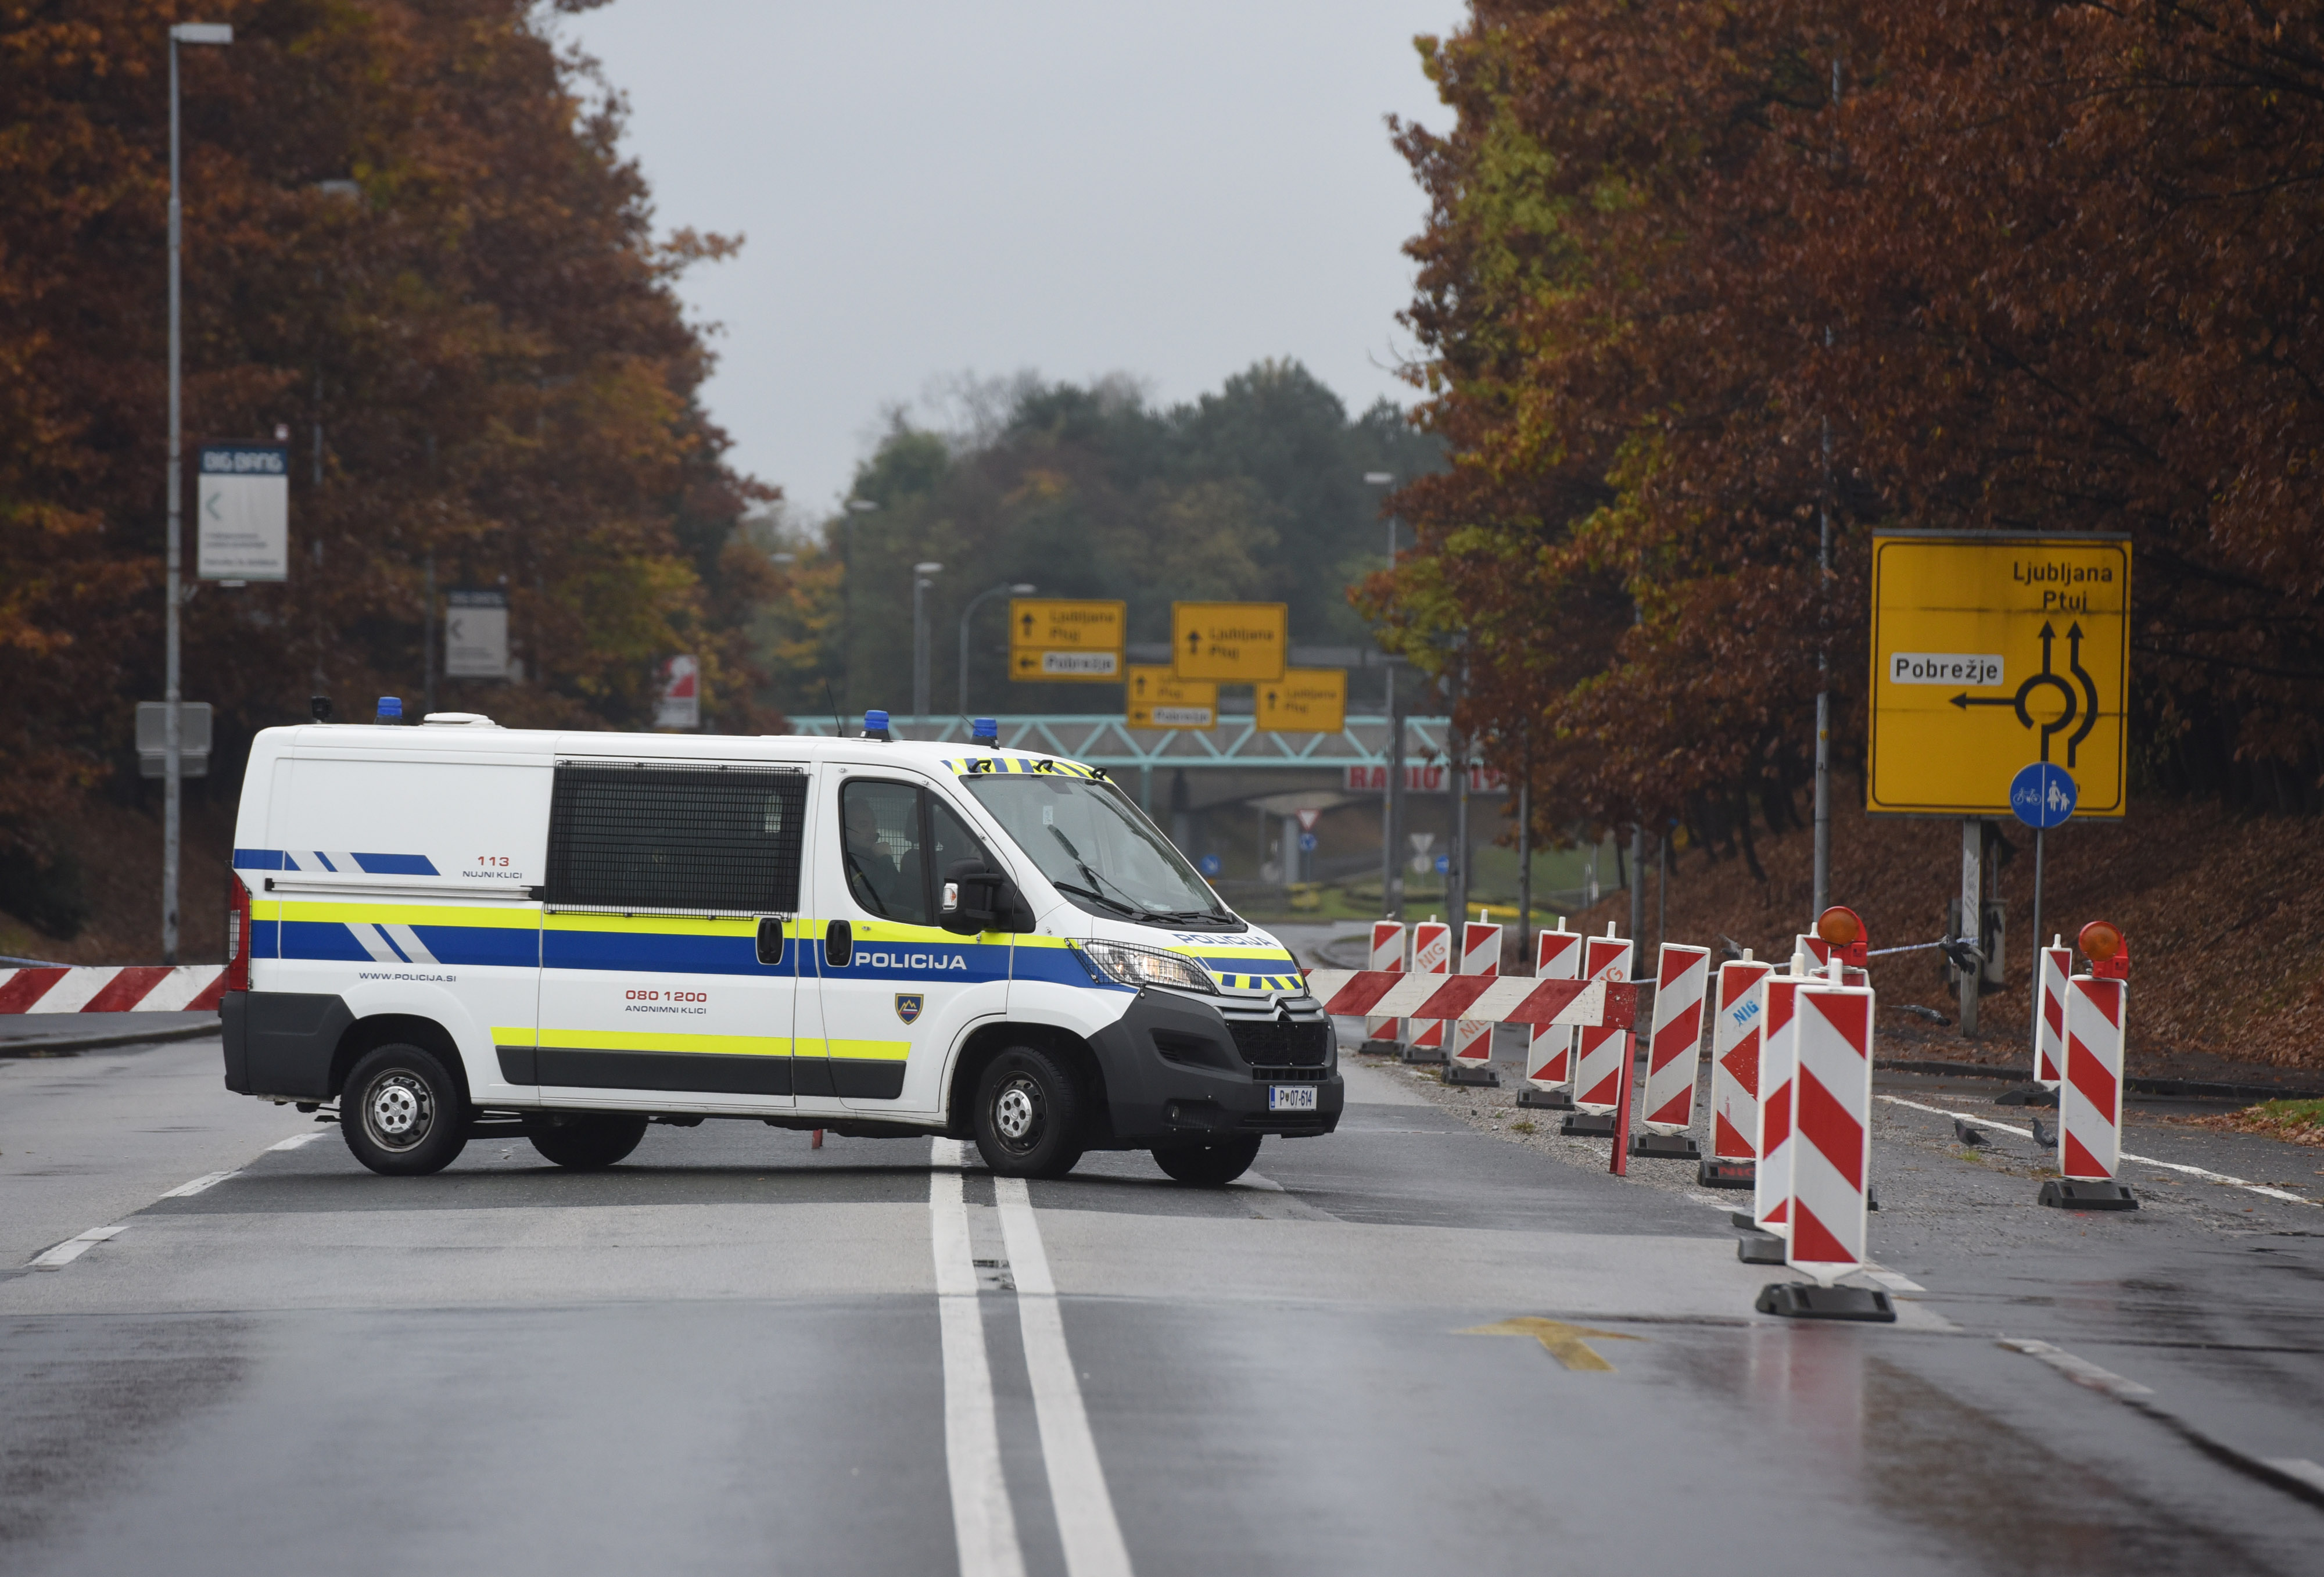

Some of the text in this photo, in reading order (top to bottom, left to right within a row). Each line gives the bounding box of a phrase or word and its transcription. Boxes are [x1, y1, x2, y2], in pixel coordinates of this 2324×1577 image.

[2014, 561, 2113, 586] Ljubljana
[2043, 590, 2087, 615] Ptuj
[1896, 658, 1997, 683] Pobrežje
[478, 856, 509, 867] 113
[1171, 933, 1278, 947] POLICIJA
[855, 952, 967, 970] POLICIJA
[1418, 942, 1446, 969] NIG
[359, 972, 457, 983] WWW.POLICIJA.SI
[626, 990, 707, 1002] 080 1200
[625, 1005, 706, 1015] ANONIMNI KLICI
[1733, 1000, 1759, 1024] NIG
[1459, 1020, 1488, 1040] NI
